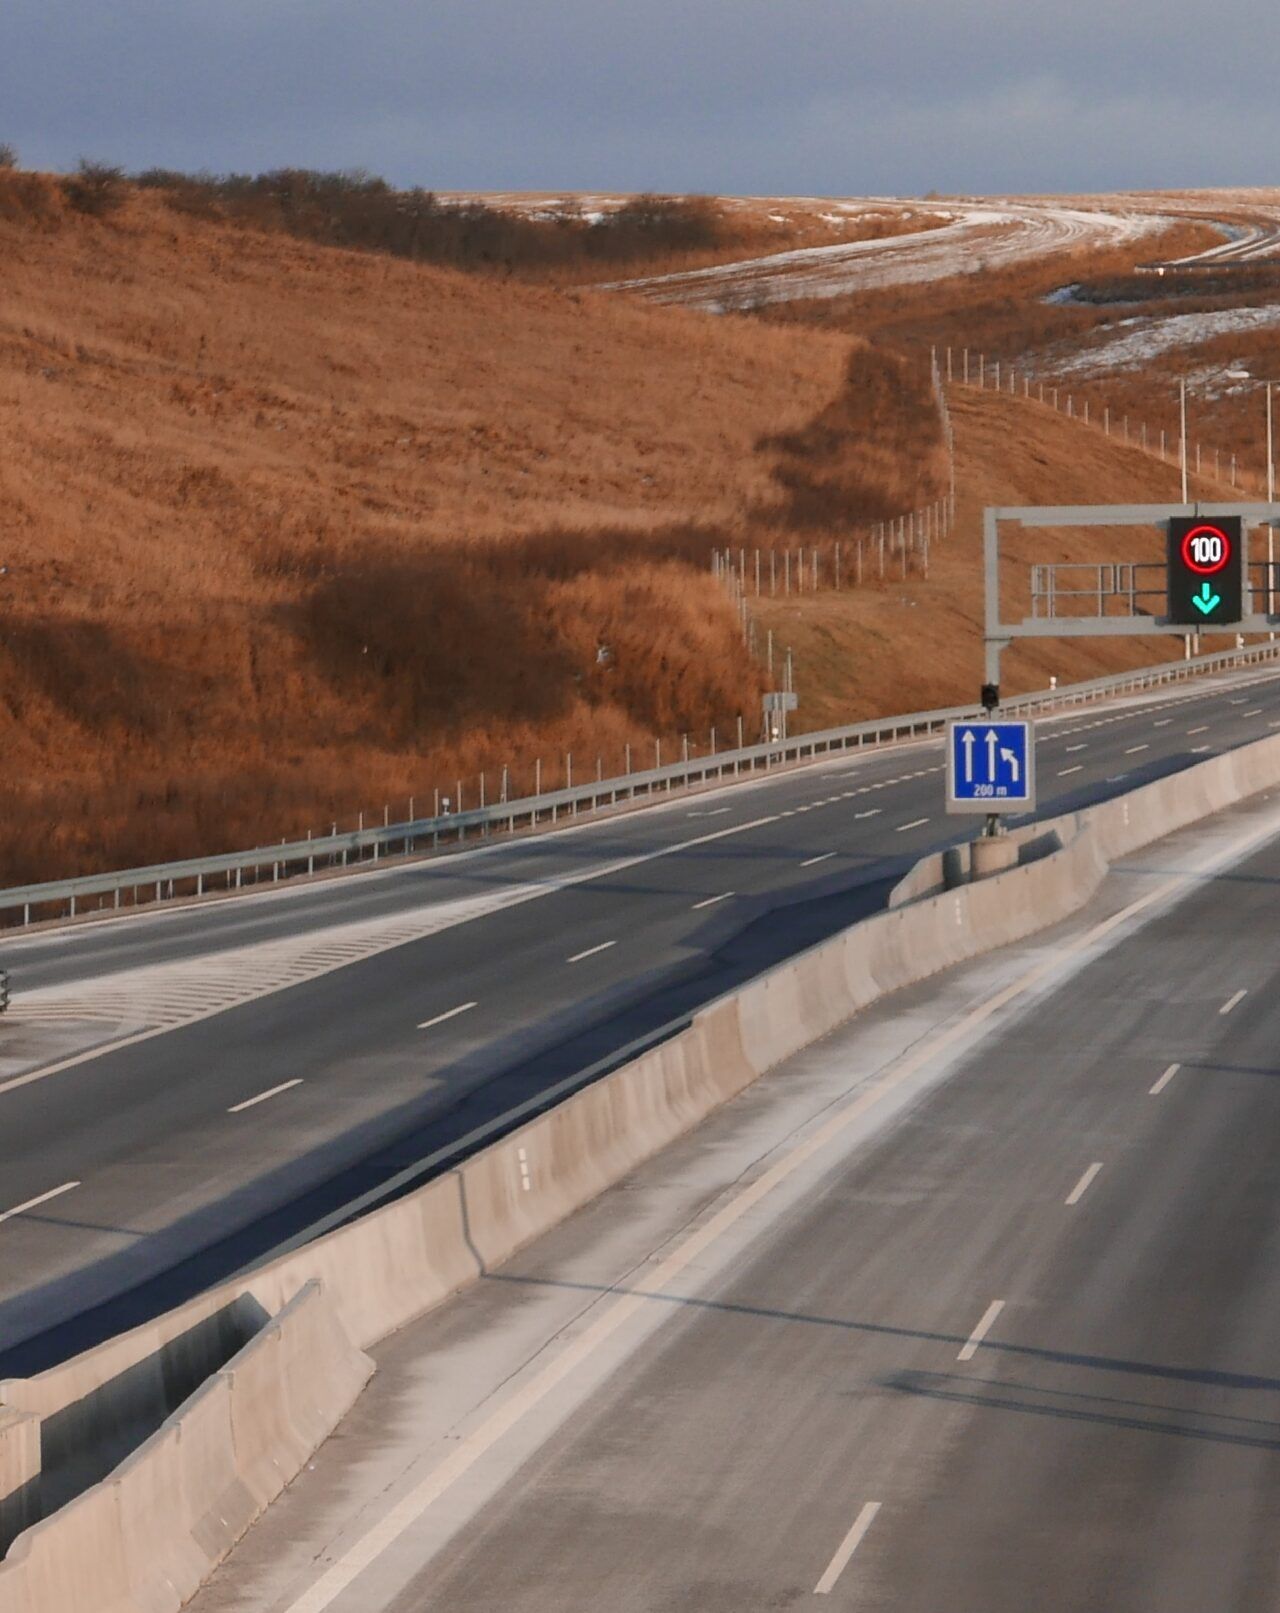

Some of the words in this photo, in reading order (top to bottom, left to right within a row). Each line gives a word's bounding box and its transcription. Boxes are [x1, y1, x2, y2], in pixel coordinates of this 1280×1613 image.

[1190, 537, 1221, 562] 100
[973, 784, 994, 797] 200
[996, 786, 1008, 796] m
